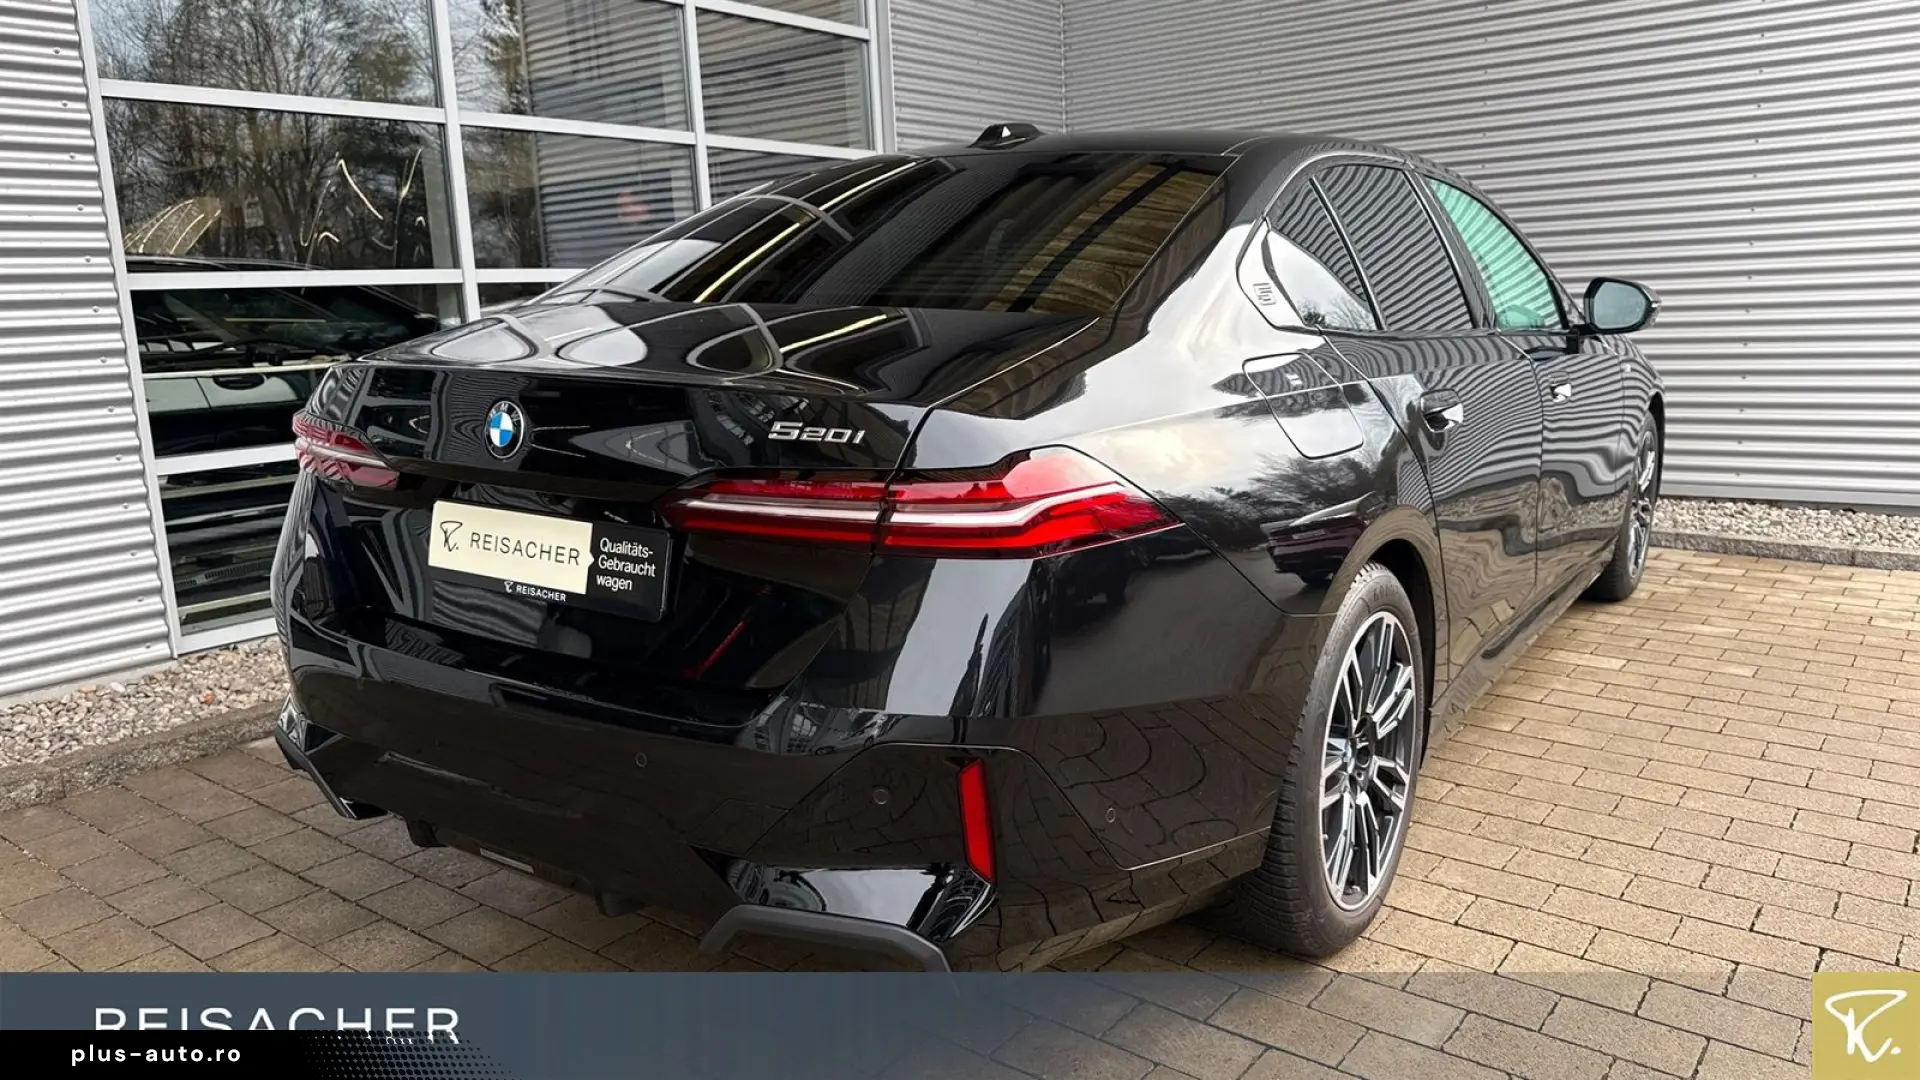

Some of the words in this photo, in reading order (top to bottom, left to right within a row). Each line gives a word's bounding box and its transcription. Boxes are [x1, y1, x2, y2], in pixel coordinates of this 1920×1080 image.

[470, 532, 580, 566] REISACHER
[600, 537, 654, 559] Qualitäts-
[598, 554, 656, 577] Gebraucht
[515, 584, 566, 602] REISACHER
[596, 574, 633, 592] wagen
